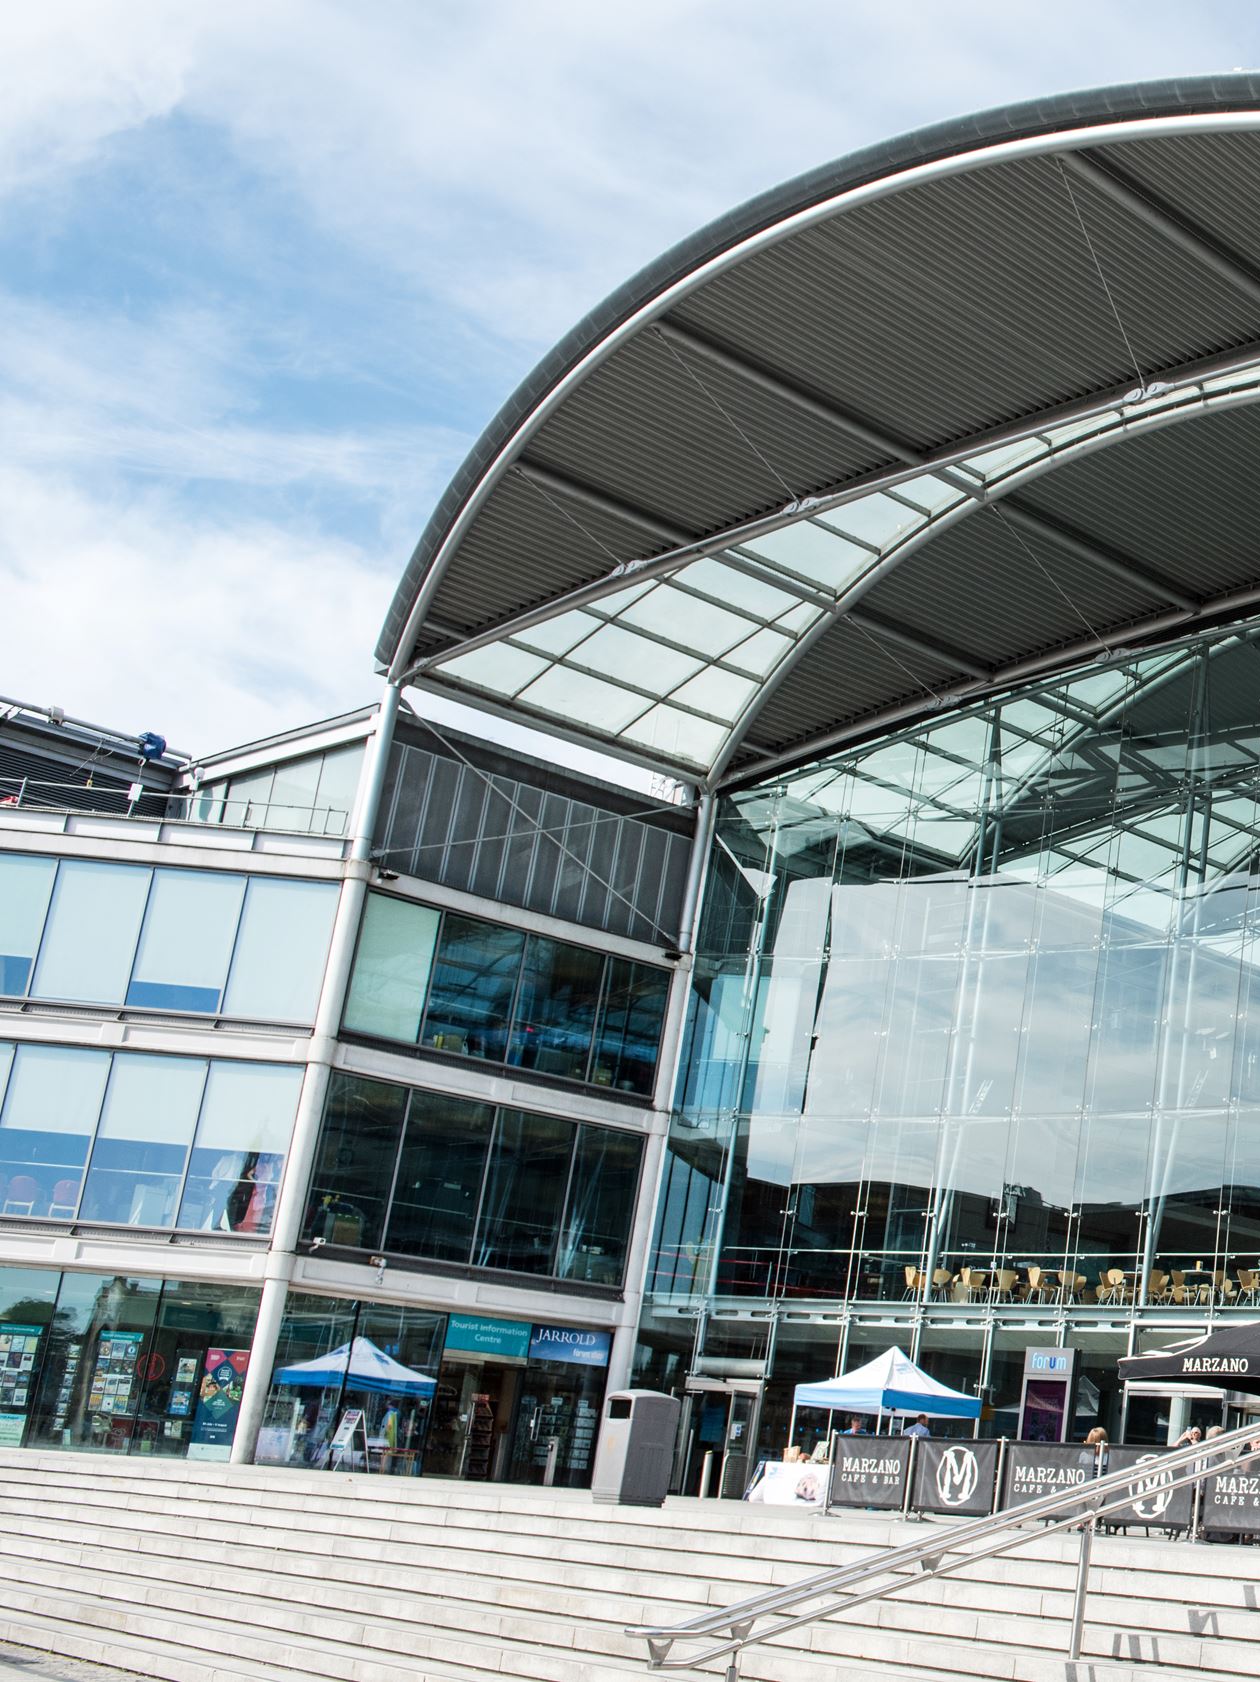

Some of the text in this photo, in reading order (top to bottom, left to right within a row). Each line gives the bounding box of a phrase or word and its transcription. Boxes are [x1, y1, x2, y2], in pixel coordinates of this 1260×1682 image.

[451, 1320, 528, 1337] Tourist Information
[474, 1334, 502, 1344] Centre
[536, 1329, 596, 1346] JARROLD
[1032, 1352, 1067, 1370] forum
[1182, 1358, 1249, 1373] MARZANO
[843, 1457, 900, 1475] MARZANO
[942, 1450, 974, 1499] M
[841, 1474, 900, 1485] CAFE & BAR
[1015, 1466, 1085, 1485] MARZANO
[1013, 1483, 1042, 1494] CAFE
[1214, 1495, 1244, 1506] CAFE
[1253, 1497, 1260, 1507] &
